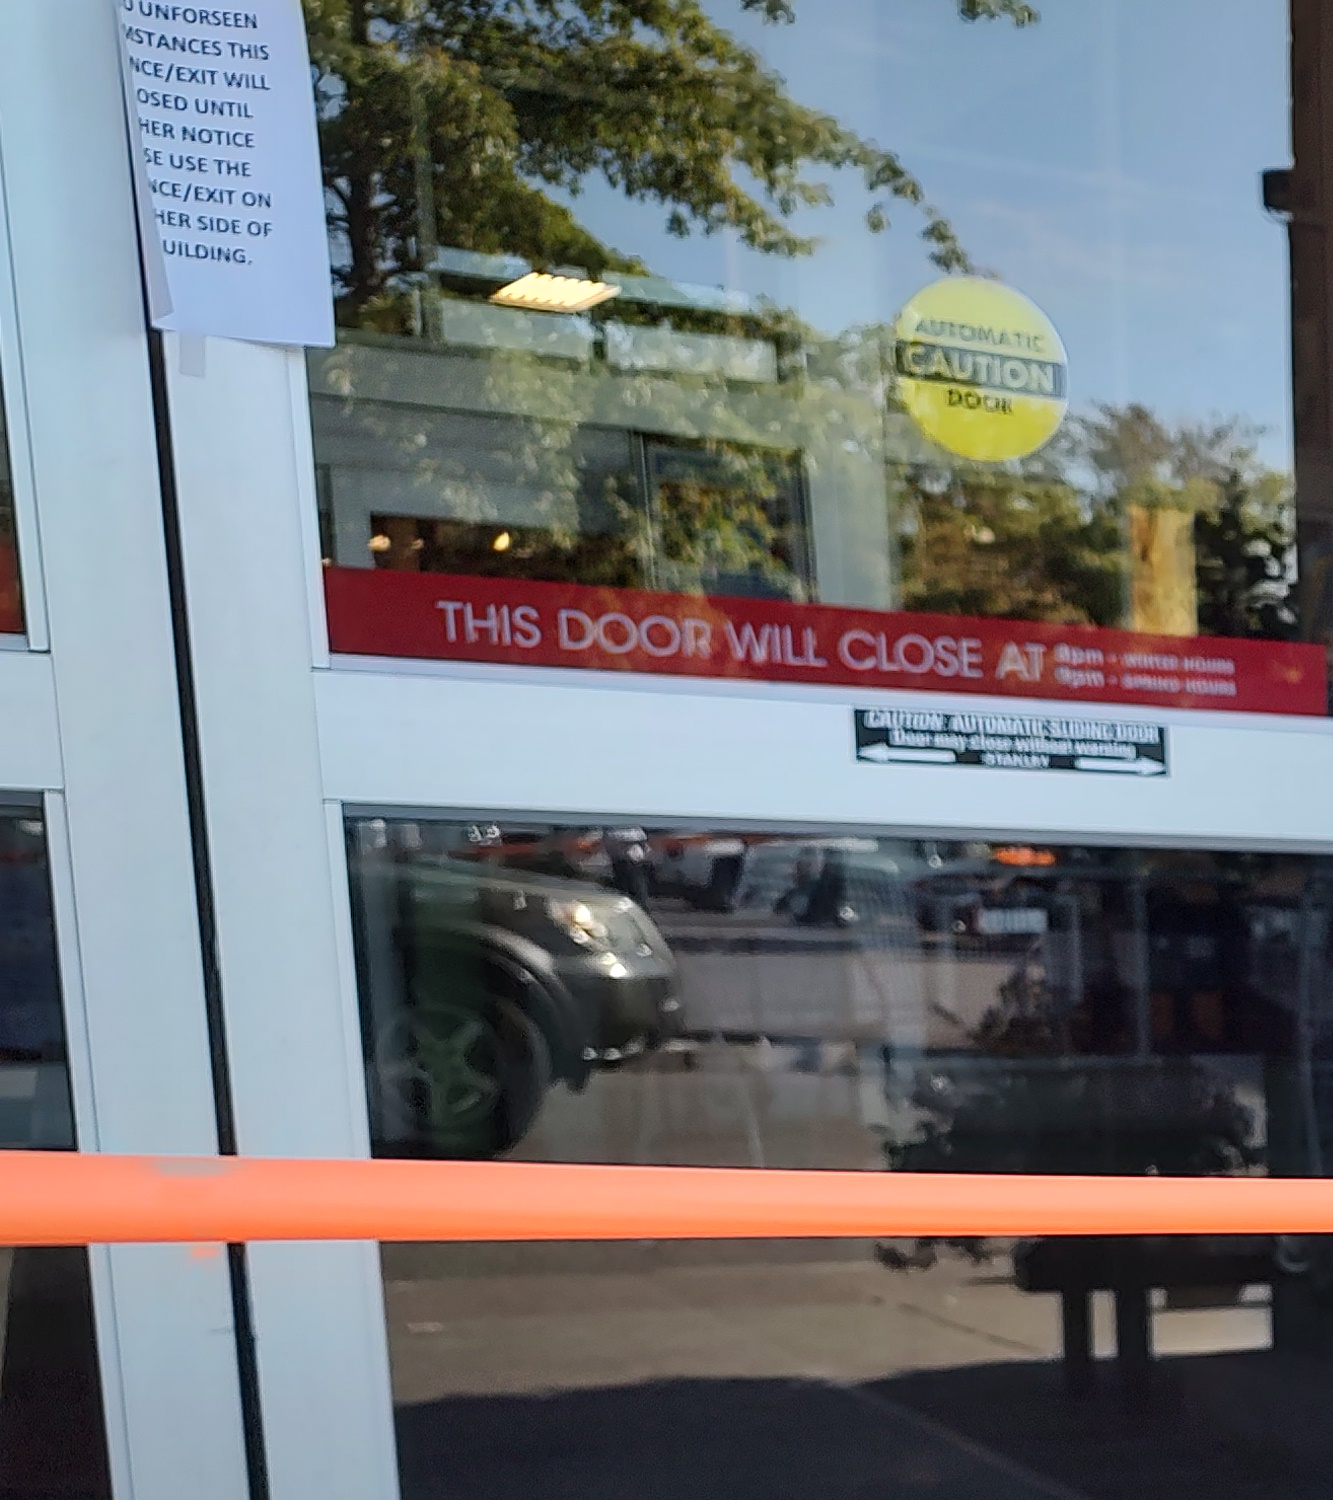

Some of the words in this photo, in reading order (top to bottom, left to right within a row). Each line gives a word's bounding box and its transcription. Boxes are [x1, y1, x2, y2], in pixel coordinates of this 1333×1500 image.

[139, 0, 257, 29] UNFORSEEN
[228, 43, 269, 60] THIS
[224, 72, 270, 90] WILL
[195, 98, 253, 118] UNTIL
[182, 126, 255, 148] NOTICE
[169, 153, 209, 173] USE
[213, 159, 251, 177] THE
[241, 191, 271, 208] ON
[197, 215, 241, 235] SIDE
[247, 219, 272, 237] OF
[915, 318, 1046, 352] AUTOMATIC
[906, 343, 1054, 393] CAUTION
[946, 388, 1014, 415] DOOR
[436, 601, 543, 648] THIS
[558, 608, 712, 658] DOOR
[725, 620, 827, 668] WILL
[838, 628, 984, 678] CLOSE
[996, 642, 1046, 682] AT
